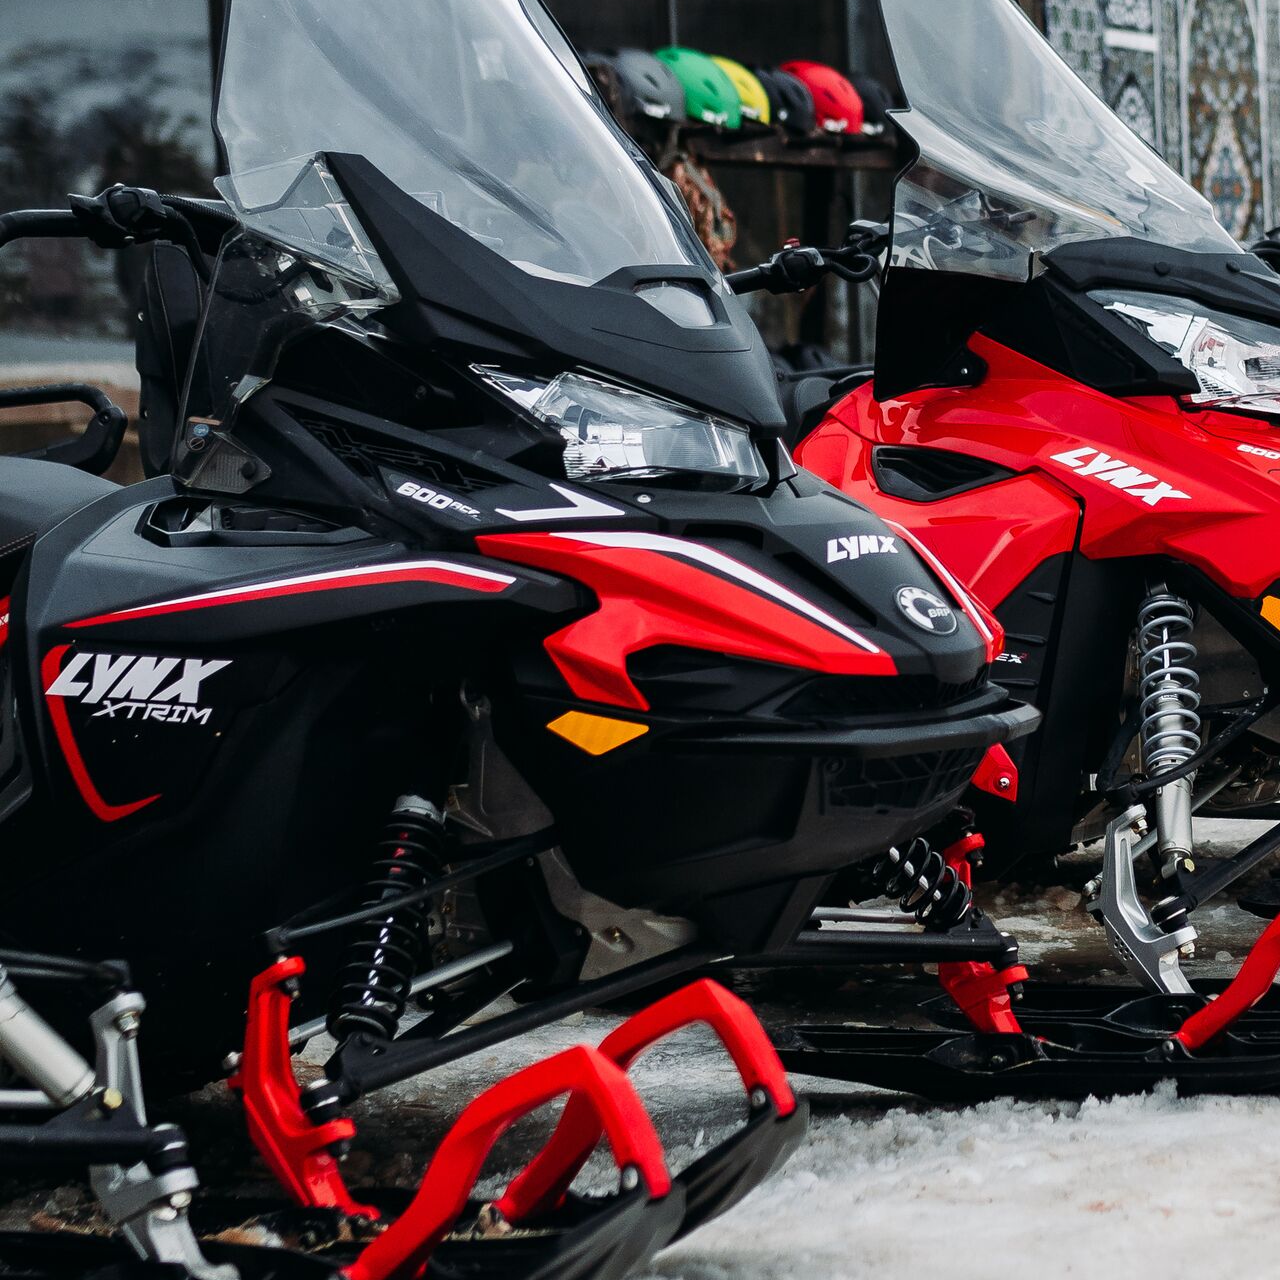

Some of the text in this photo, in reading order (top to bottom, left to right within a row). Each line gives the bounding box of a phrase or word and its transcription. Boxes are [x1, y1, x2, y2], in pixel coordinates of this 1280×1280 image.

[1049, 446, 1192, 506] LYNX
[826, 535, 899, 564] LYNX
[928, 608, 950, 618] BRP
[44, 652, 234, 704] LYNX
[91, 700, 213, 725] XTRIM
